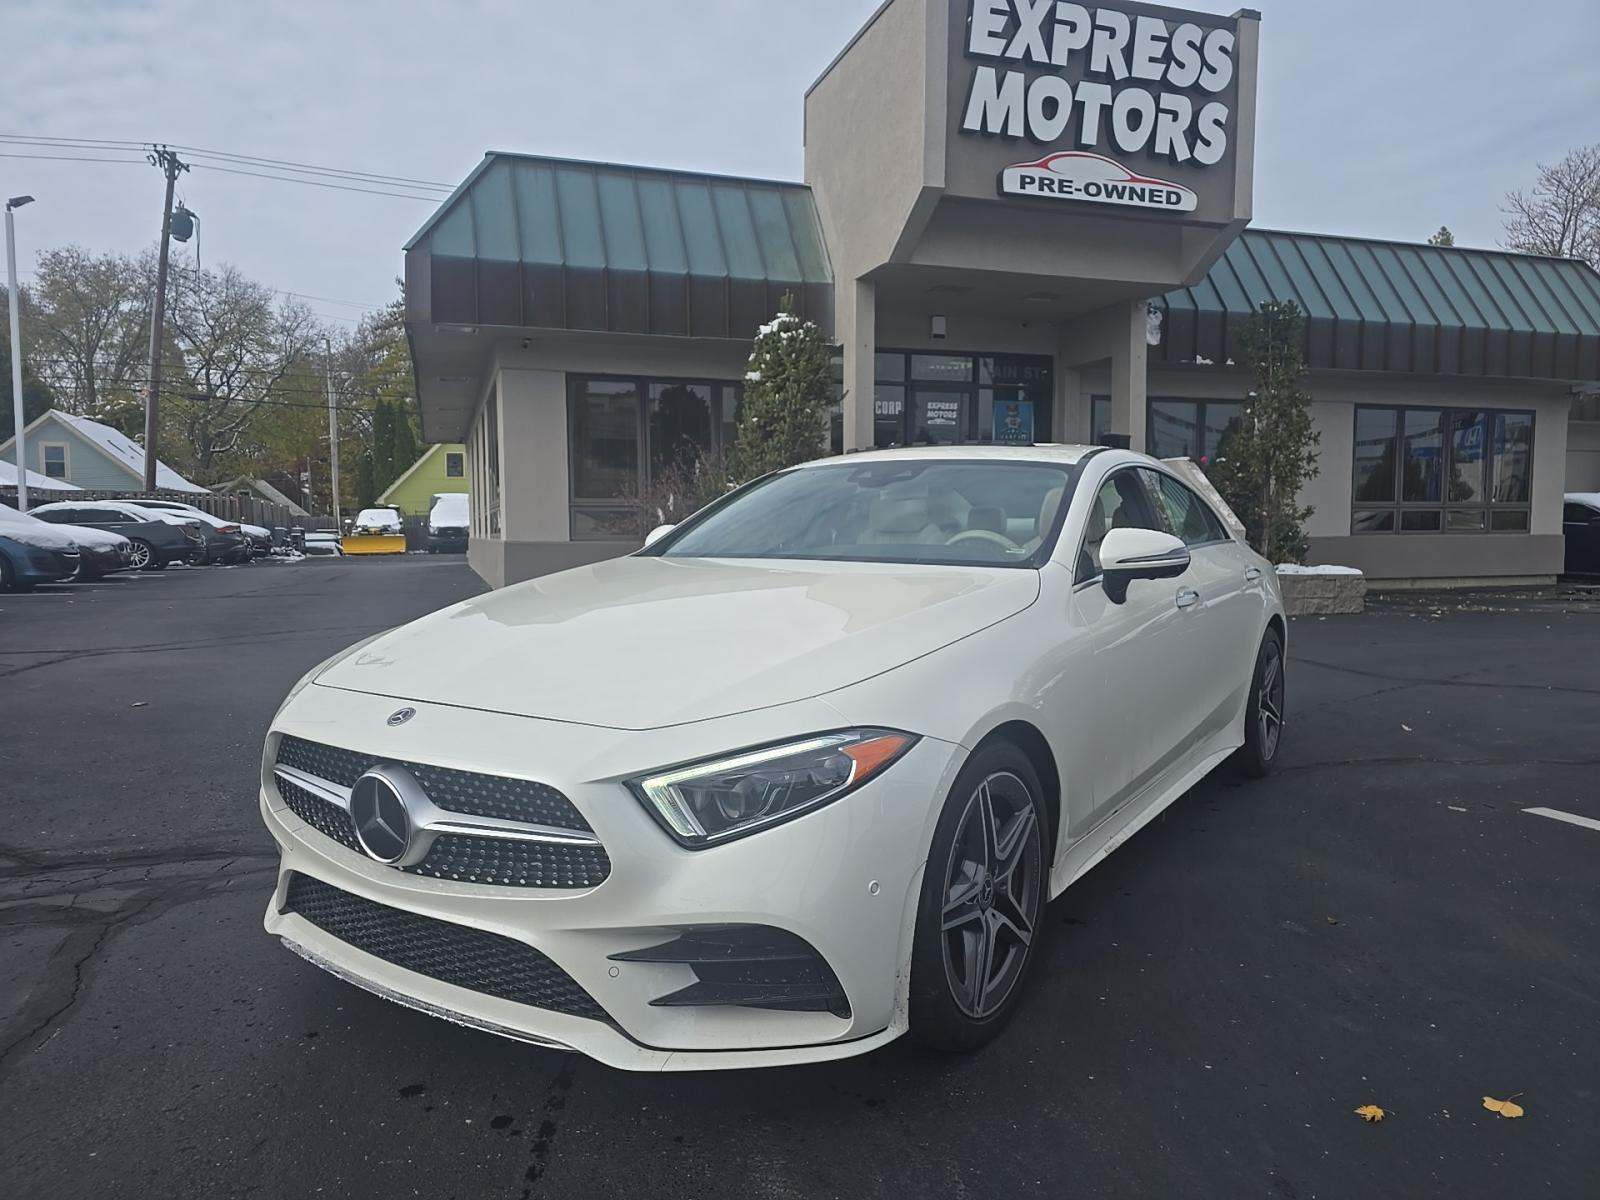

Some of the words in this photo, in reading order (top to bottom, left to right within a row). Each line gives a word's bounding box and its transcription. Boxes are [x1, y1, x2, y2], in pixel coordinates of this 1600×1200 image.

[969, 0, 1235, 93] EXPRESS
[963, 66, 1229, 165] MOTORS
[1019, 174, 1182, 206] PRE-OWNED
[926, 410, 957, 419] MOTORS
[927, 402, 958, 410] EXPRESS
